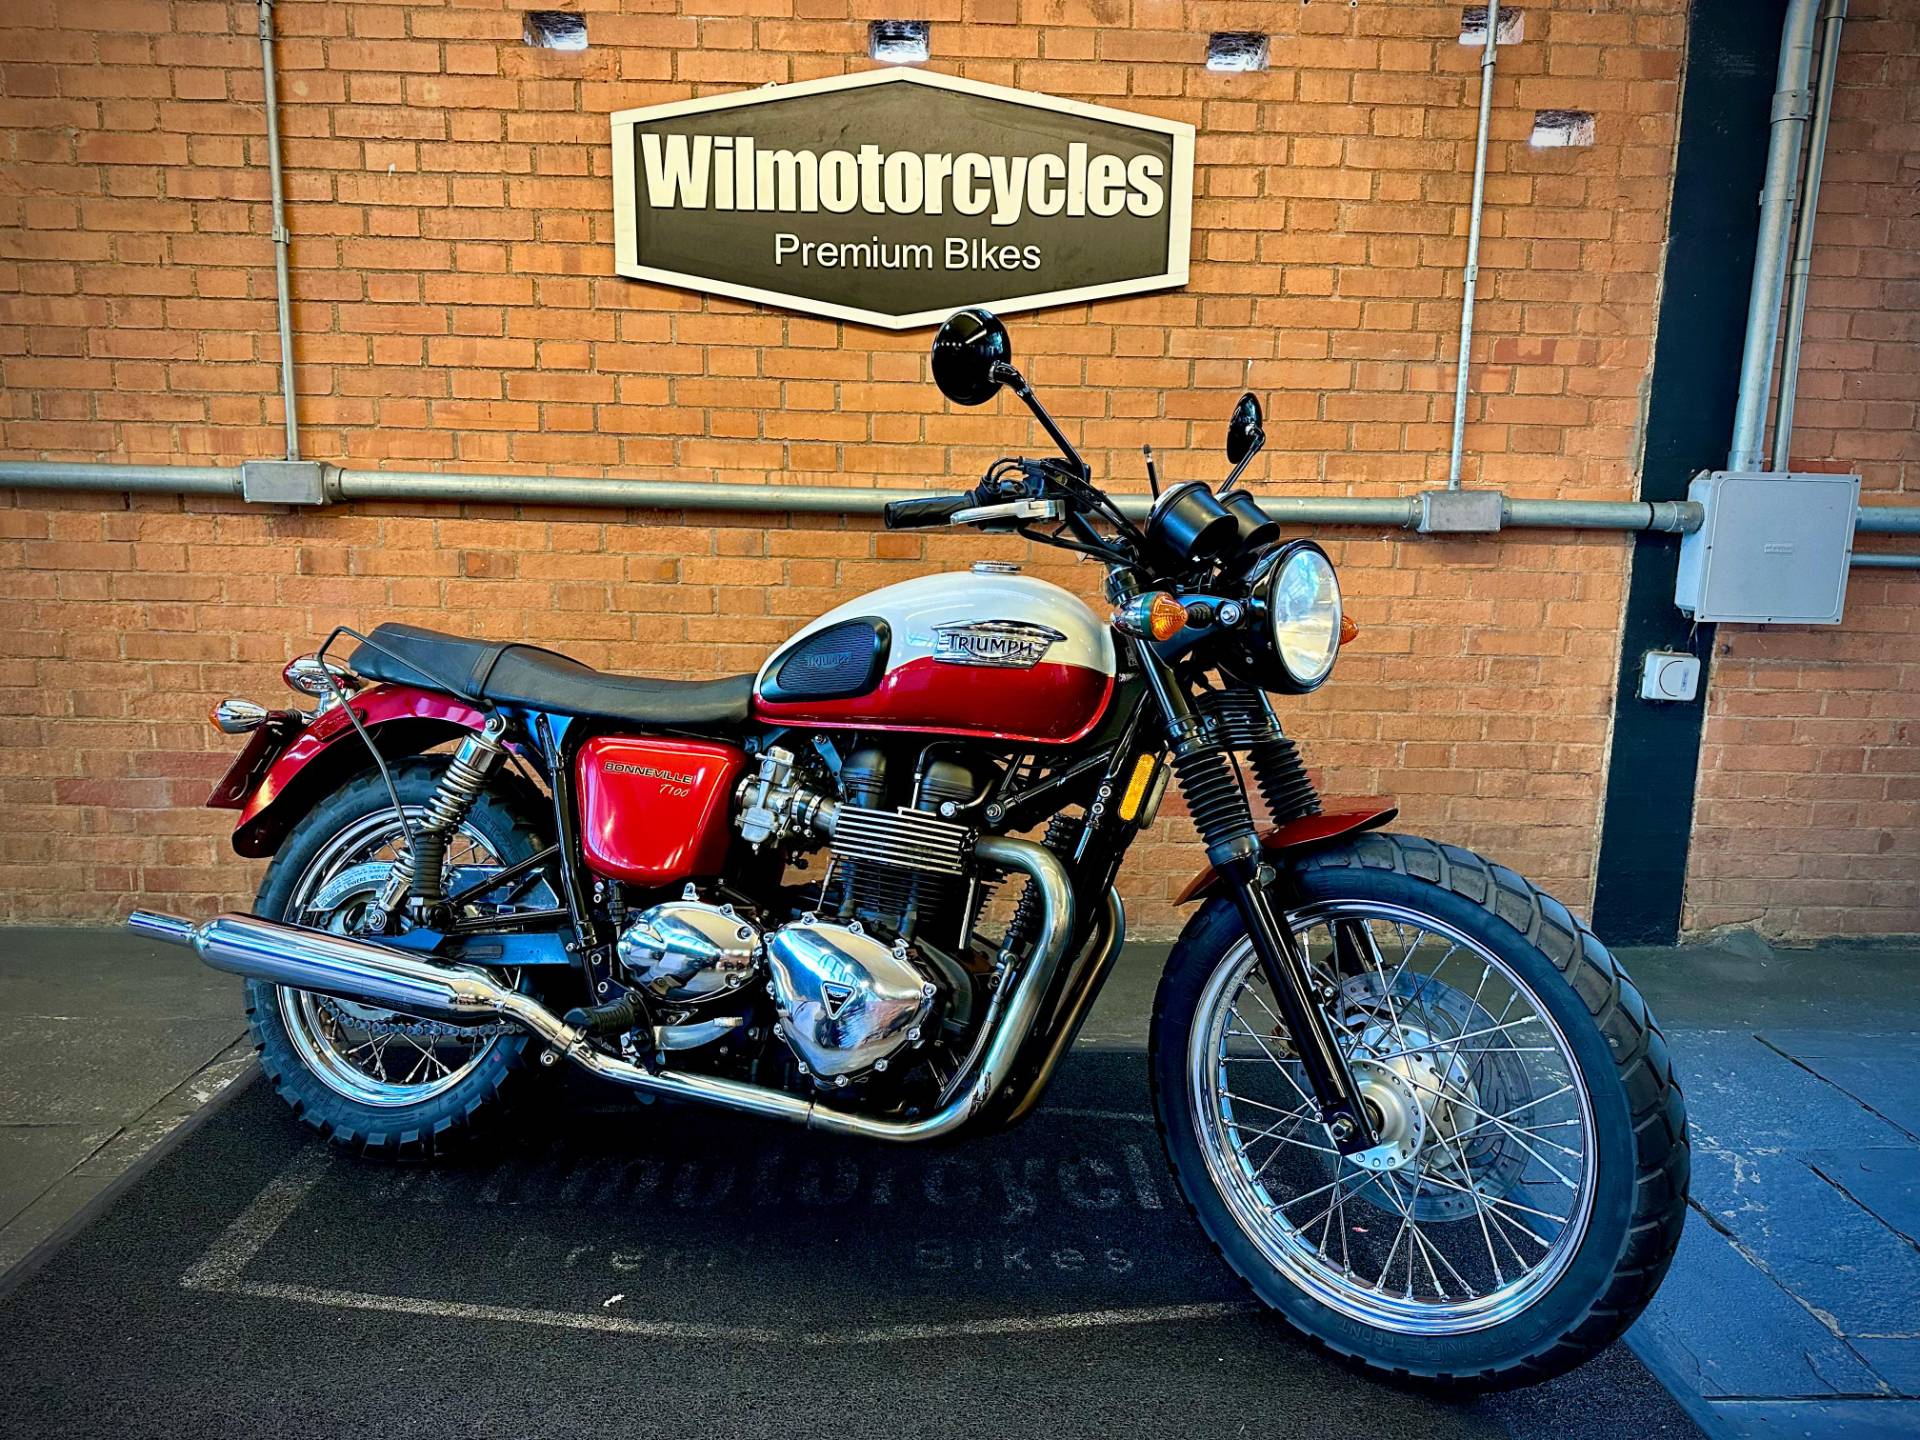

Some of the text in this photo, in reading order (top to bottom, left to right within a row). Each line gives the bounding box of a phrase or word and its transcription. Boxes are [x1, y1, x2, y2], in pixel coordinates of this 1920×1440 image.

[641, 133, 1165, 225] Wilmotorcycles
[774, 233, 933, 269] Premium
[946, 633, 1033, 658] TRIUMPH
[604, 761, 694, 785] BONNEVILLE
[659, 783, 690, 798] T100
